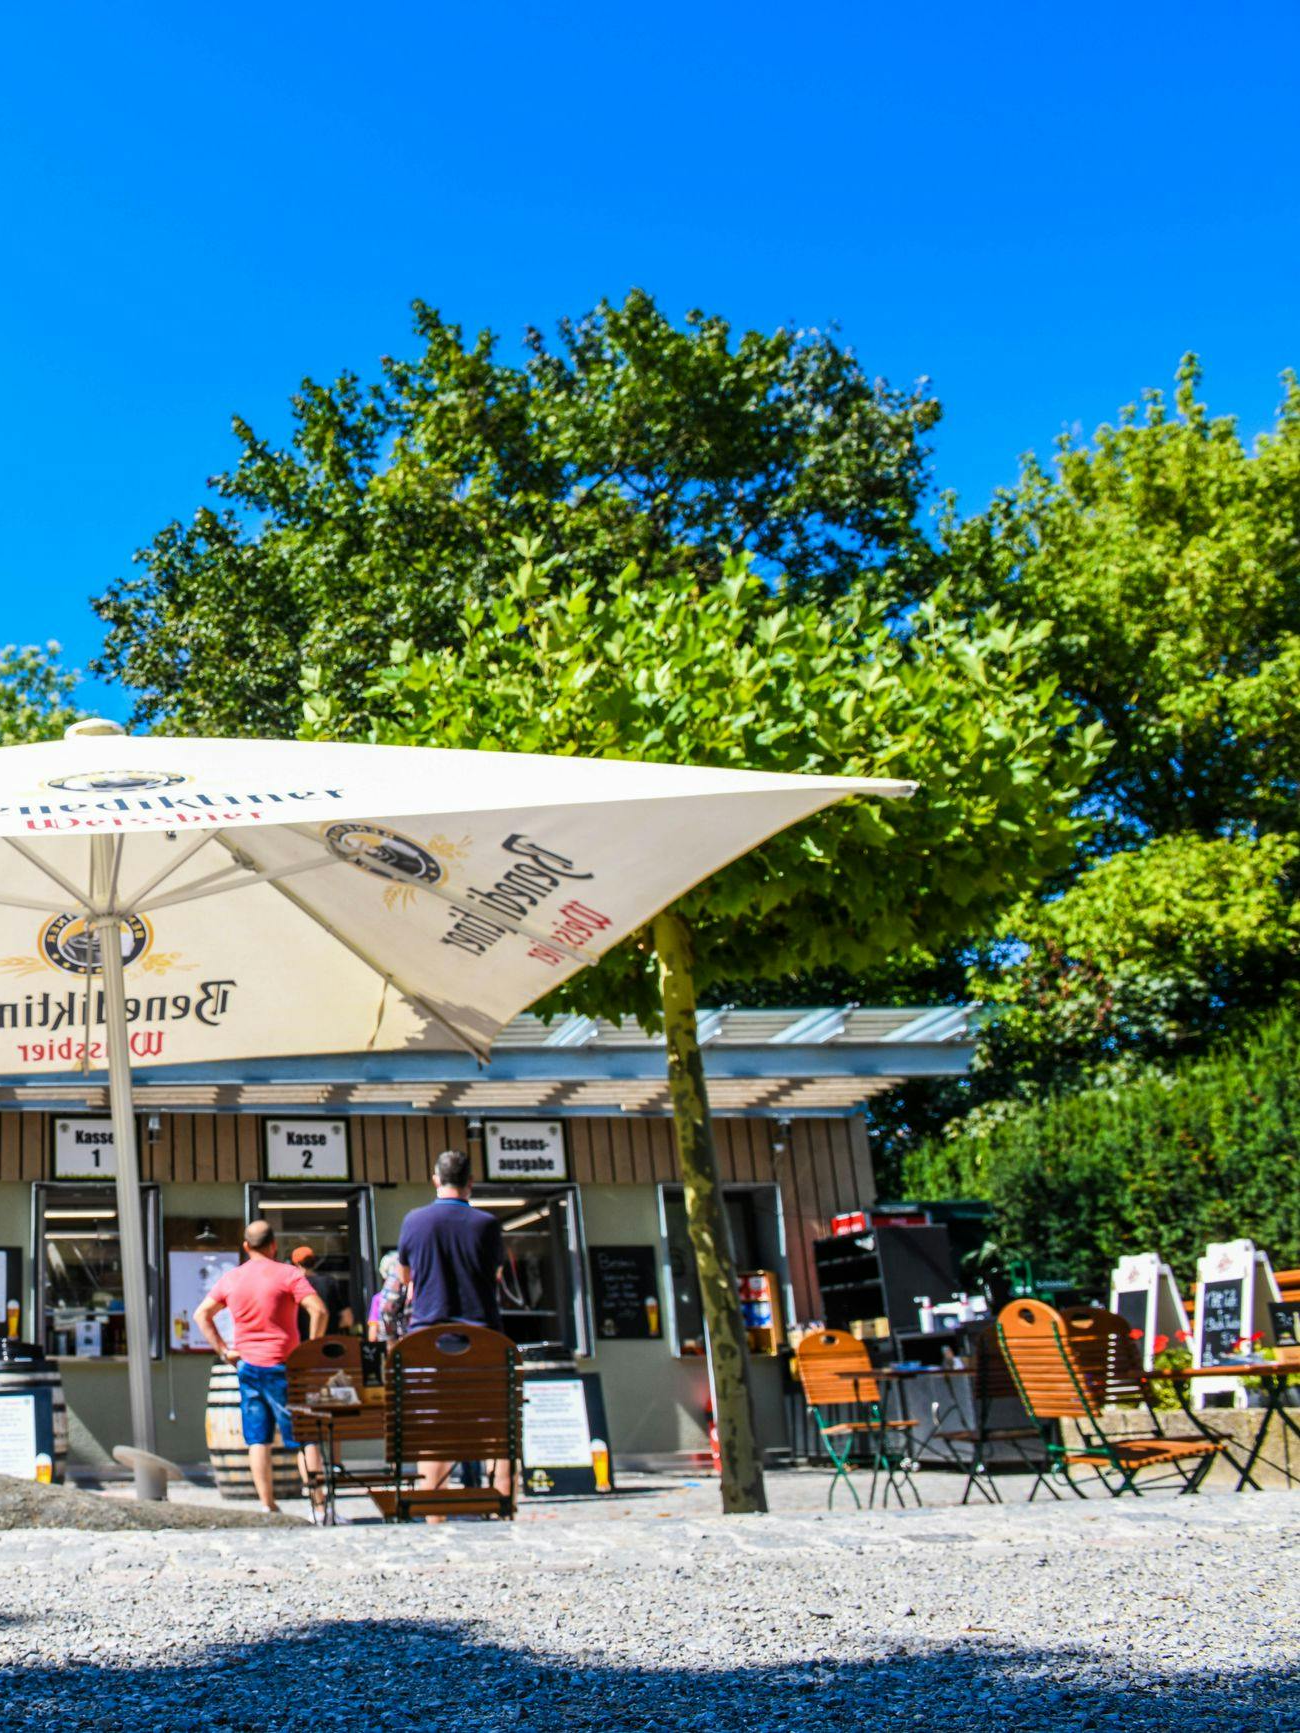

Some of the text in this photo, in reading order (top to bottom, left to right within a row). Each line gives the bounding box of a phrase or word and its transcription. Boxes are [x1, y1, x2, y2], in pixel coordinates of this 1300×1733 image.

[75, 1130, 114, 1145] Kasse
[286, 1131, 327, 1146] Kasse
[500, 1137, 550, 1151] Essens-
[91, 1149, 100, 1168] 1
[302, 1149, 313, 1169] 2
[498, 1156, 555, 1172] ausgabe
